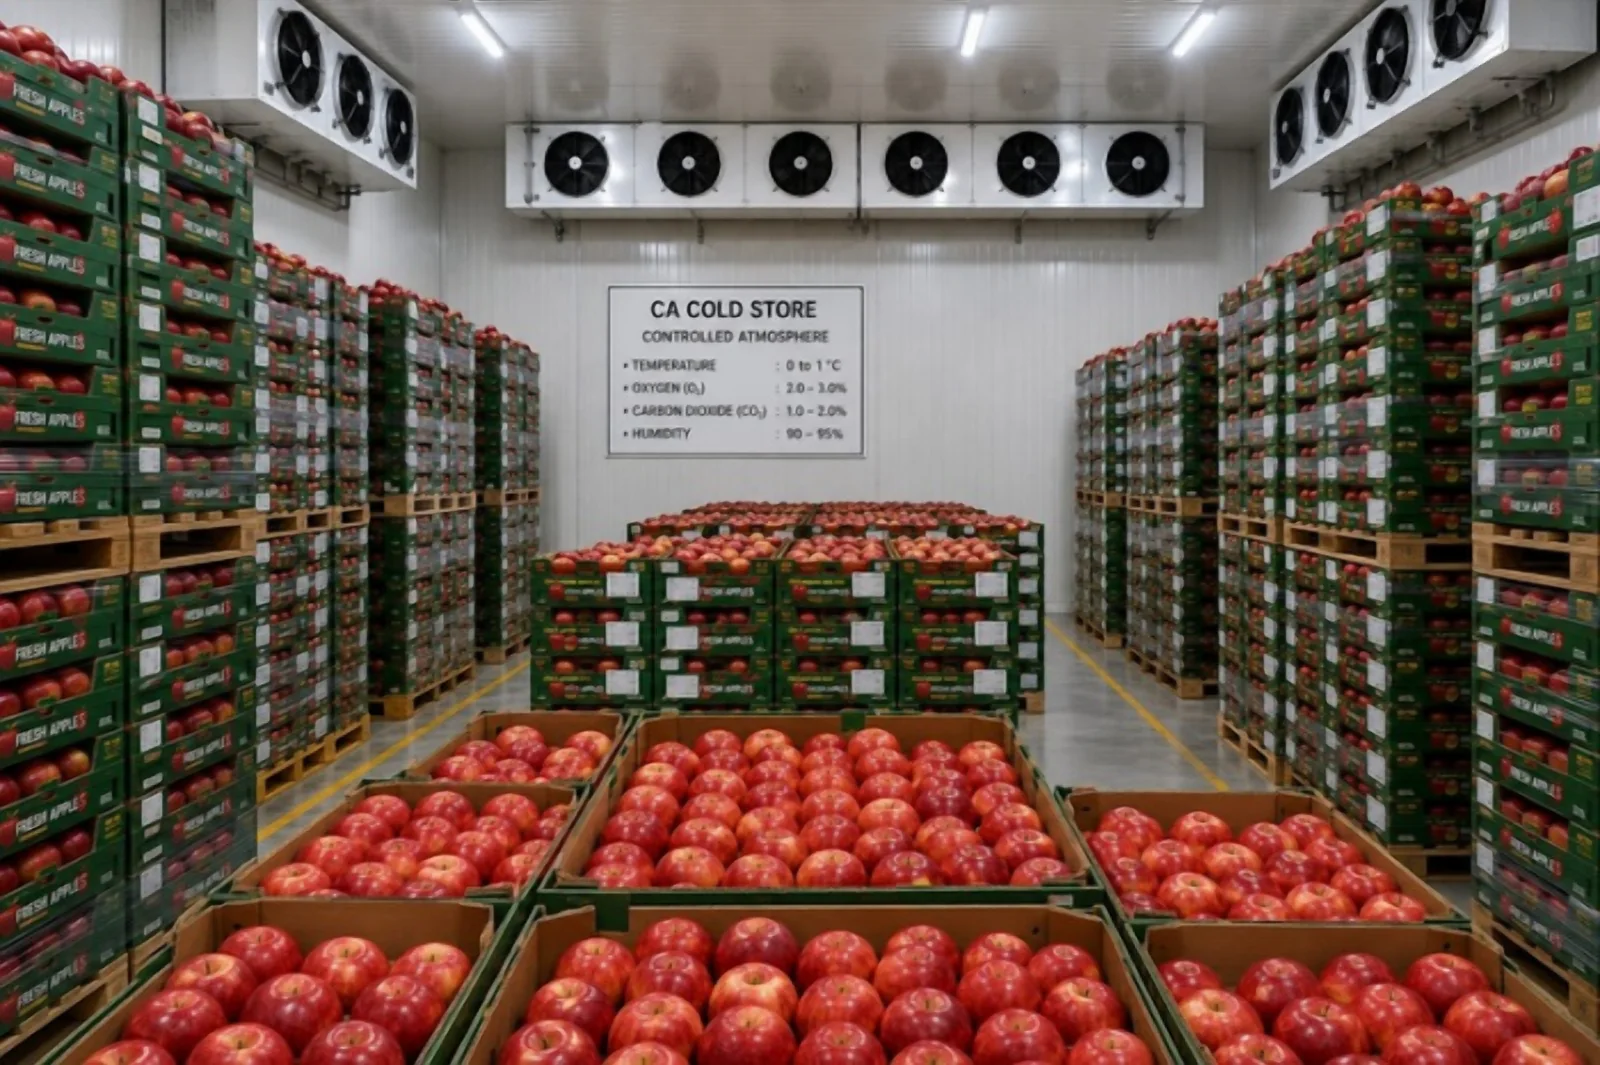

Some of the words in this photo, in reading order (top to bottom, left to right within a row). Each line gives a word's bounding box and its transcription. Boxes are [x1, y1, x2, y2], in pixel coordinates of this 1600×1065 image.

[650, 300, 681, 319] CA
[686, 300, 744, 319] COLD
[750, 300, 818, 319] STORE
[642, 329, 734, 343] CONTROLLED
[738, 329, 830, 343] ATMOSPHERE
[632, 359, 717, 372] TEMPERATURE
[786, 359, 796, 372] 0
[798, 360, 812, 372] to
[631, 382, 681, 394] OXYGEN
[786, 382, 806, 394] 2.0
[631, 404, 683, 417] CARBON
[685, 404, 734, 417] DIOXIDE
[786, 404, 806, 417] 1.0
[632, 427, 692, 440] HUMIDITY
[785, 427, 803, 440] 90
[815, 427, 845, 440] 95%
[16, 641, 46, 661] FRESH
[49, 632, 85, 654] APPLES
[16, 728, 47, 747] FRESH
[50, 712, 87, 736] APPLES
[16, 811, 47, 836] FRESH
[50, 793, 87, 821] APPLES
[16, 895, 48, 923] FRESH
[50, 873, 87, 906] APPLES
